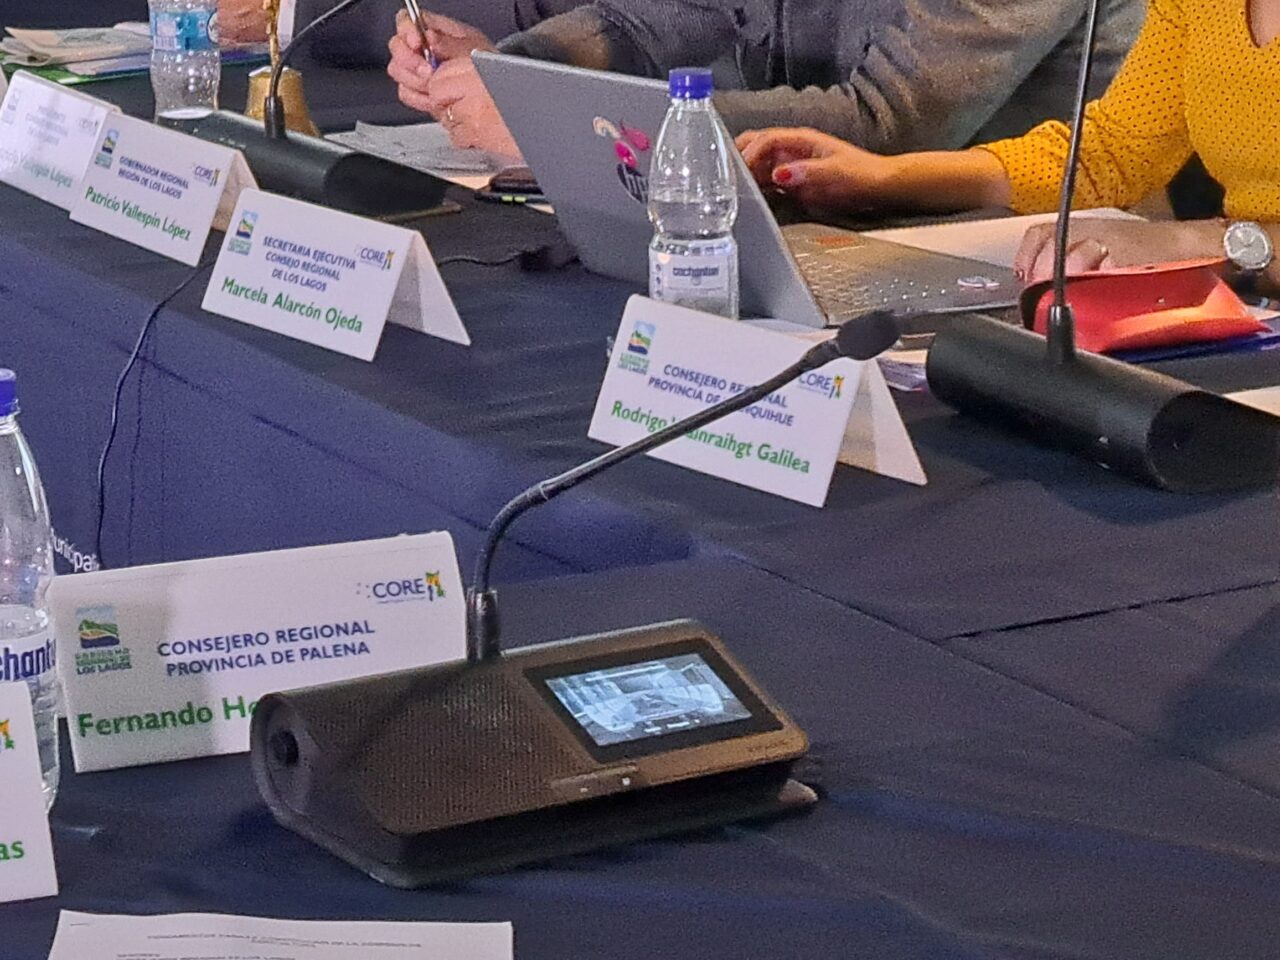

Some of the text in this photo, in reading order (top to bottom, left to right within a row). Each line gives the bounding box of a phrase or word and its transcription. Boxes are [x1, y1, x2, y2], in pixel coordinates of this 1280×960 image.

[119, 155, 160, 178] GOBERNADOR
[160, 169, 189, 190] REGIONAL
[85, 186, 120, 212] Patricio
[162, 215, 192, 241] López
[263, 236, 310, 257] SECRETARIA
[312, 250, 356, 270] EJECUTIVA
[266, 251, 340, 281] CONSEJO REGIONAL
[360, 247, 384, 262] CORE
[271, 269, 327, 292] DE LOS LAGOS
[222, 277, 362, 333] Marcela Alarcón Ojeda
[648, 376, 703, 403] PROVINCIA
[663, 364, 727, 391] CONSEJERO
[798, 373, 832, 390] CORE
[611, 400, 667, 433] Rodrigo
[757, 443, 810, 474] Galilea
[372, 577, 424, 599] CORE
[157, 619, 376, 658] CONSEJERO REGIONAL
[166, 641, 371, 679] PROVINCIA DE PALENA
[78, 703, 213, 738] Fernando
